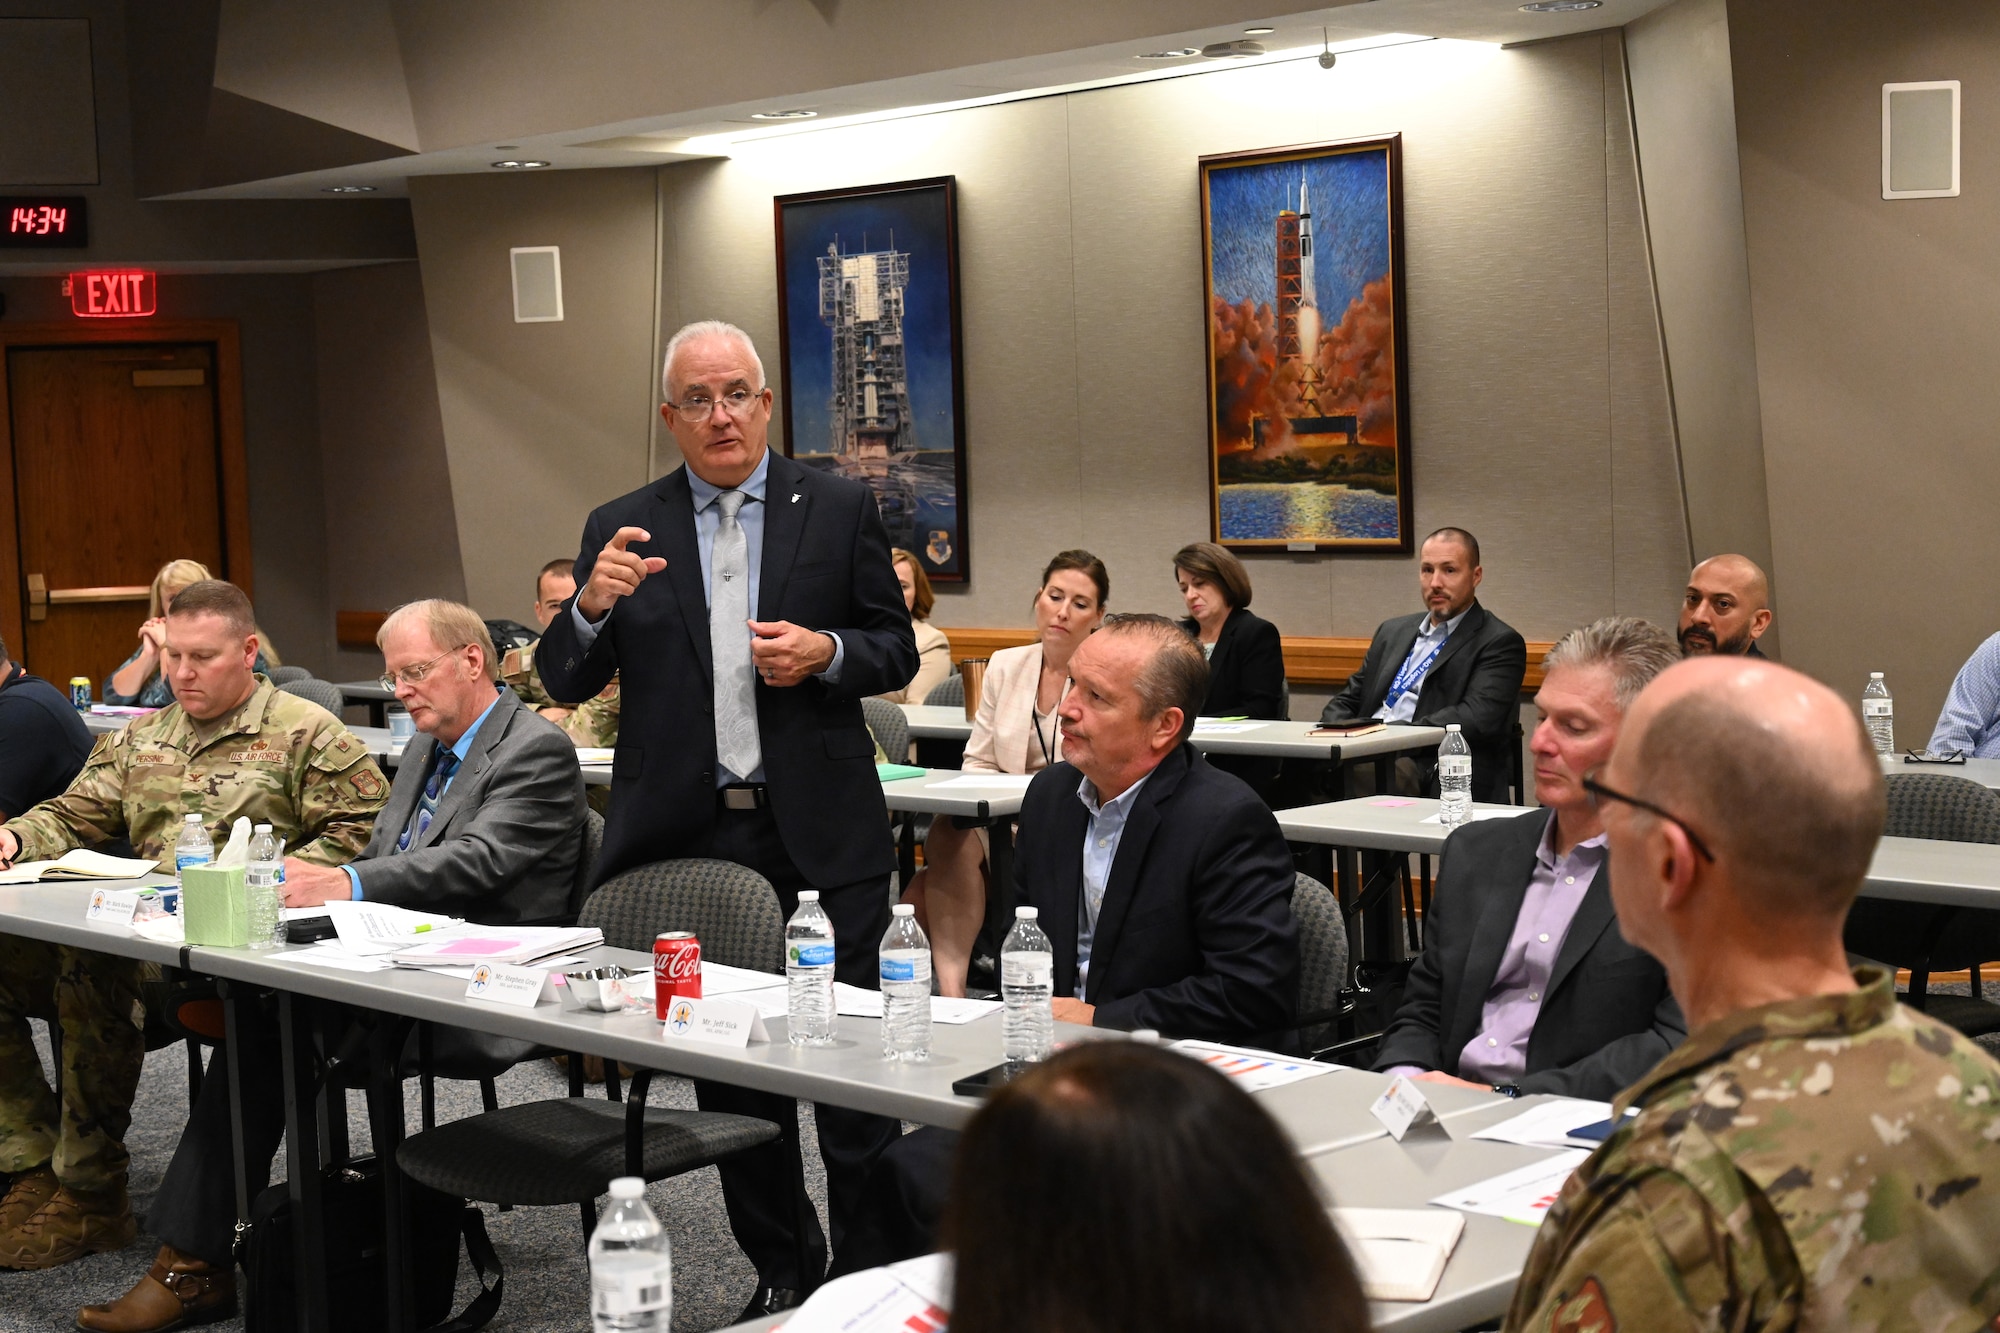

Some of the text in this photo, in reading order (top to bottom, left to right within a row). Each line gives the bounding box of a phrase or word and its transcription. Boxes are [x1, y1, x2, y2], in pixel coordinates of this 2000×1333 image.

[11, 206, 66, 235] 14:34
[86, 274, 144, 313] EXIT
[135, 754, 164, 763] PERSING
[230, 752, 282, 762] U.S. AIR FORCE
[505, 975, 525, 985] Stephen
[525, 978, 537, 988] Gray
[702, 1018, 712, 1027] Mr.
[712, 1019, 725, 1029] Jeff
